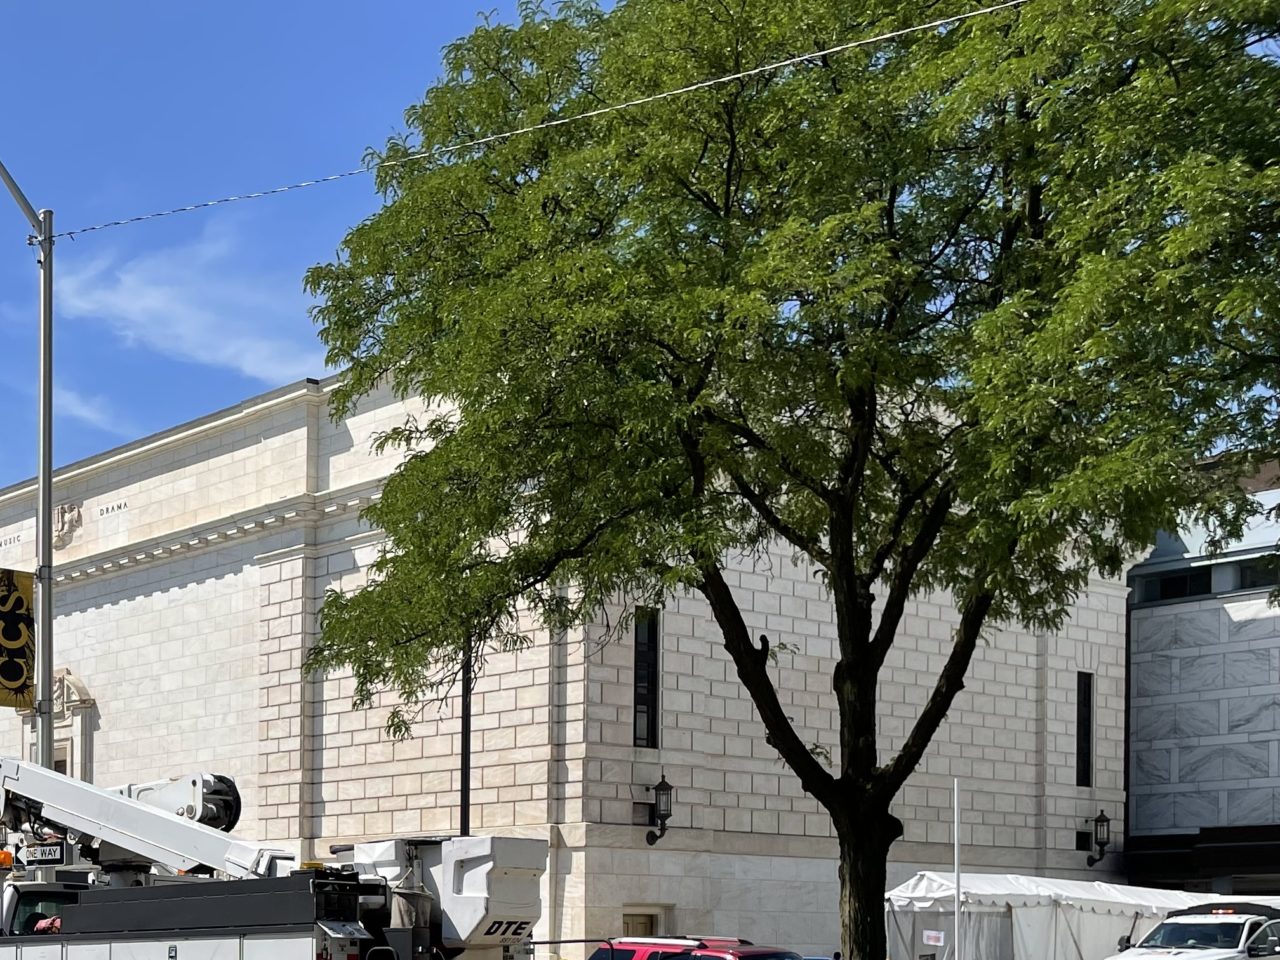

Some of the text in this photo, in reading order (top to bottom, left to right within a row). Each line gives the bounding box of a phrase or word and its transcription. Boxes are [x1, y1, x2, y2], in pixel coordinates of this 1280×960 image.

[99, 501, 129, 517] DRAMA
[40, 847, 58, 858] WAY
[483, 920, 531, 936] DTE
